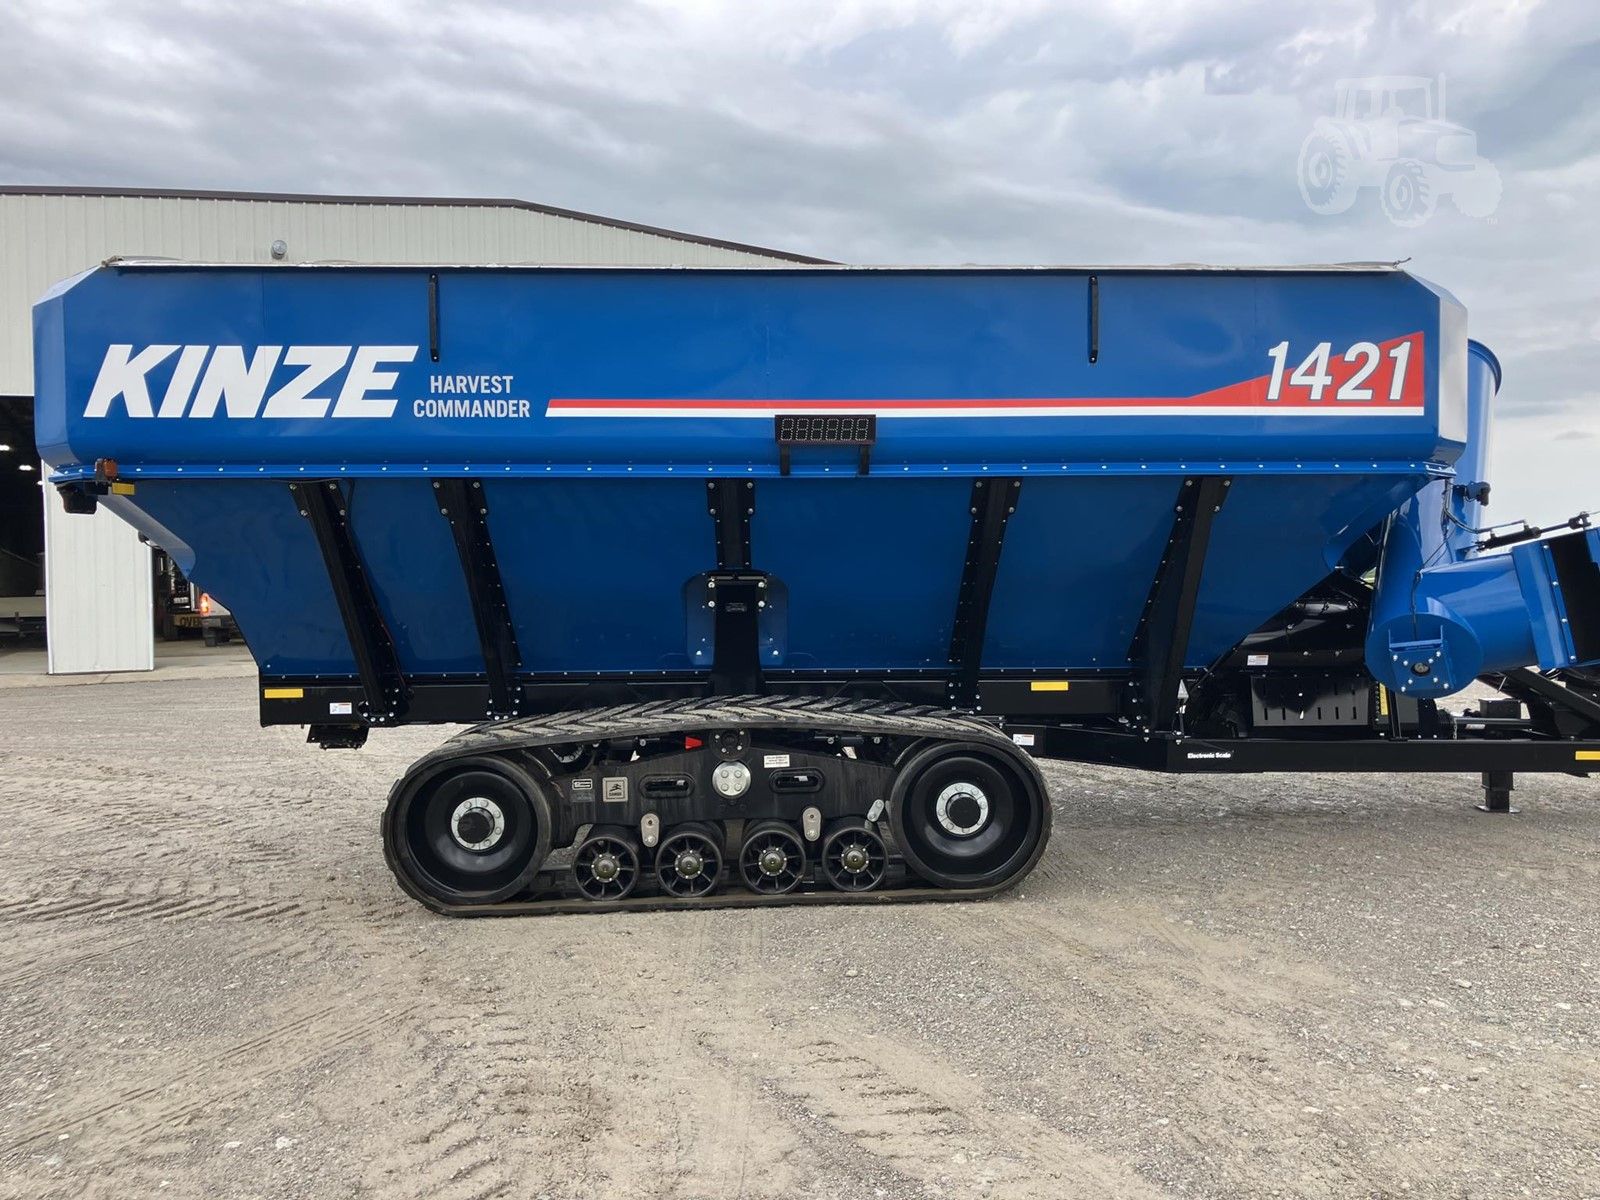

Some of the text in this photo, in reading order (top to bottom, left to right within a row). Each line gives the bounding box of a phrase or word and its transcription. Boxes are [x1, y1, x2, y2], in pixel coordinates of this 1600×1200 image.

[83, 344, 419, 418] KINZE
[430, 375, 514, 394] HARVEST
[1267, 341, 1411, 400] 1421
[413, 399, 530, 418] COMMANDER
